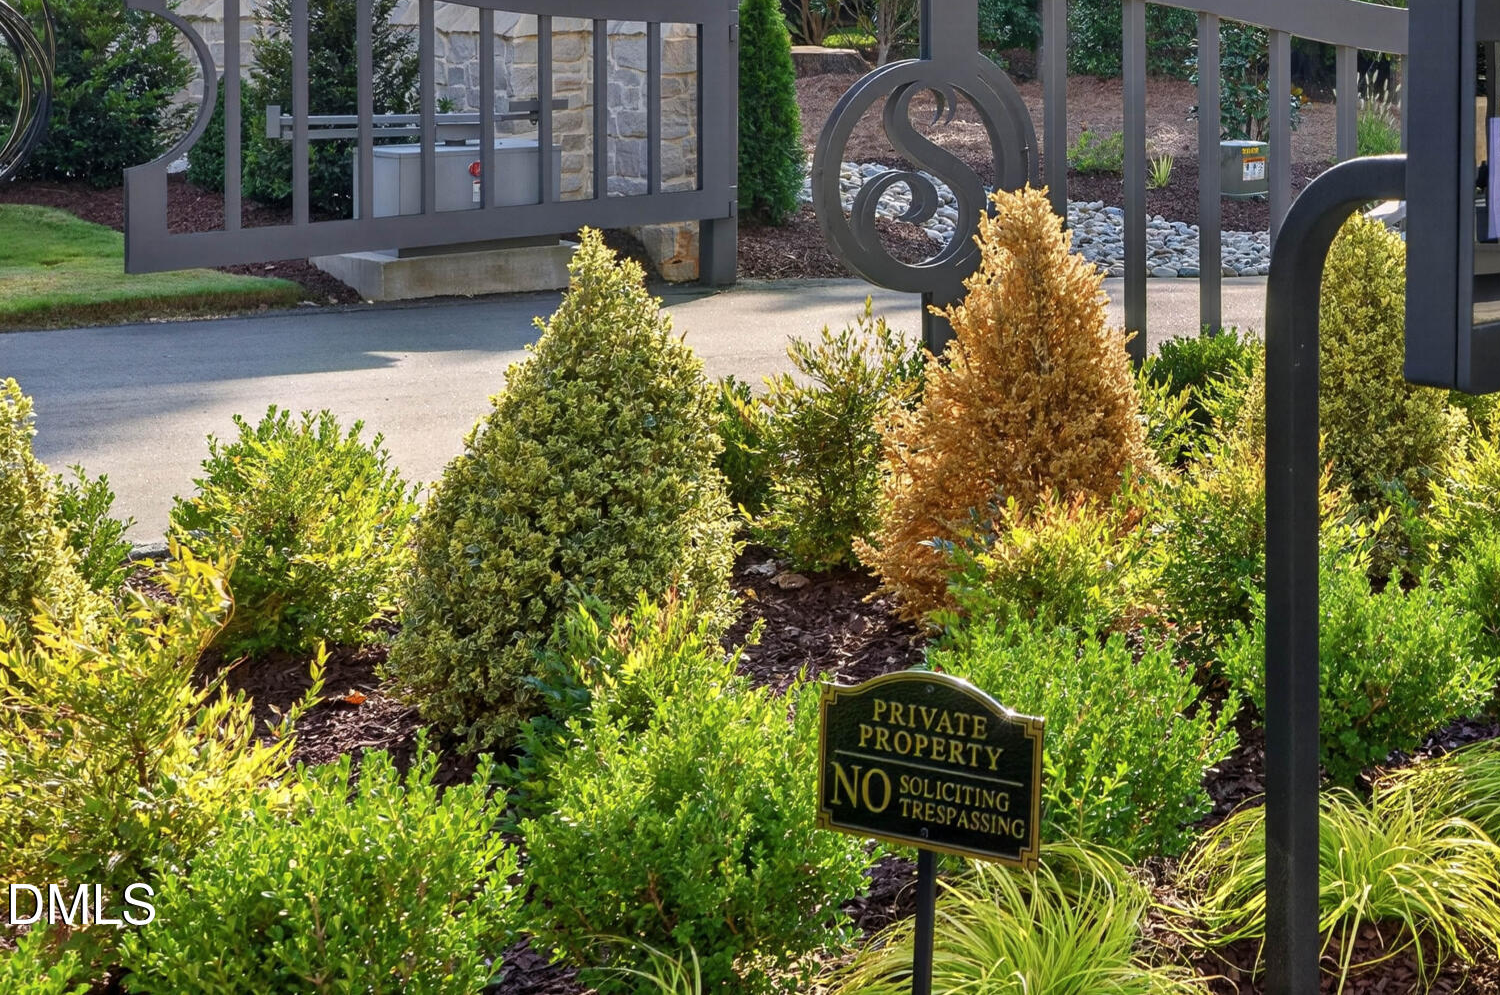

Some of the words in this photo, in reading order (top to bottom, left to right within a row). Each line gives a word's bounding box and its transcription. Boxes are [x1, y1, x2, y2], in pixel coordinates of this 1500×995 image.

[872, 698, 988, 740] PRIVATE
[858, 723, 1004, 771] PROPERTY
[830, 761, 892, 814] NO
[899, 773, 1010, 813] SOLICITING
[899, 797, 1025, 839] TRESPASSING
